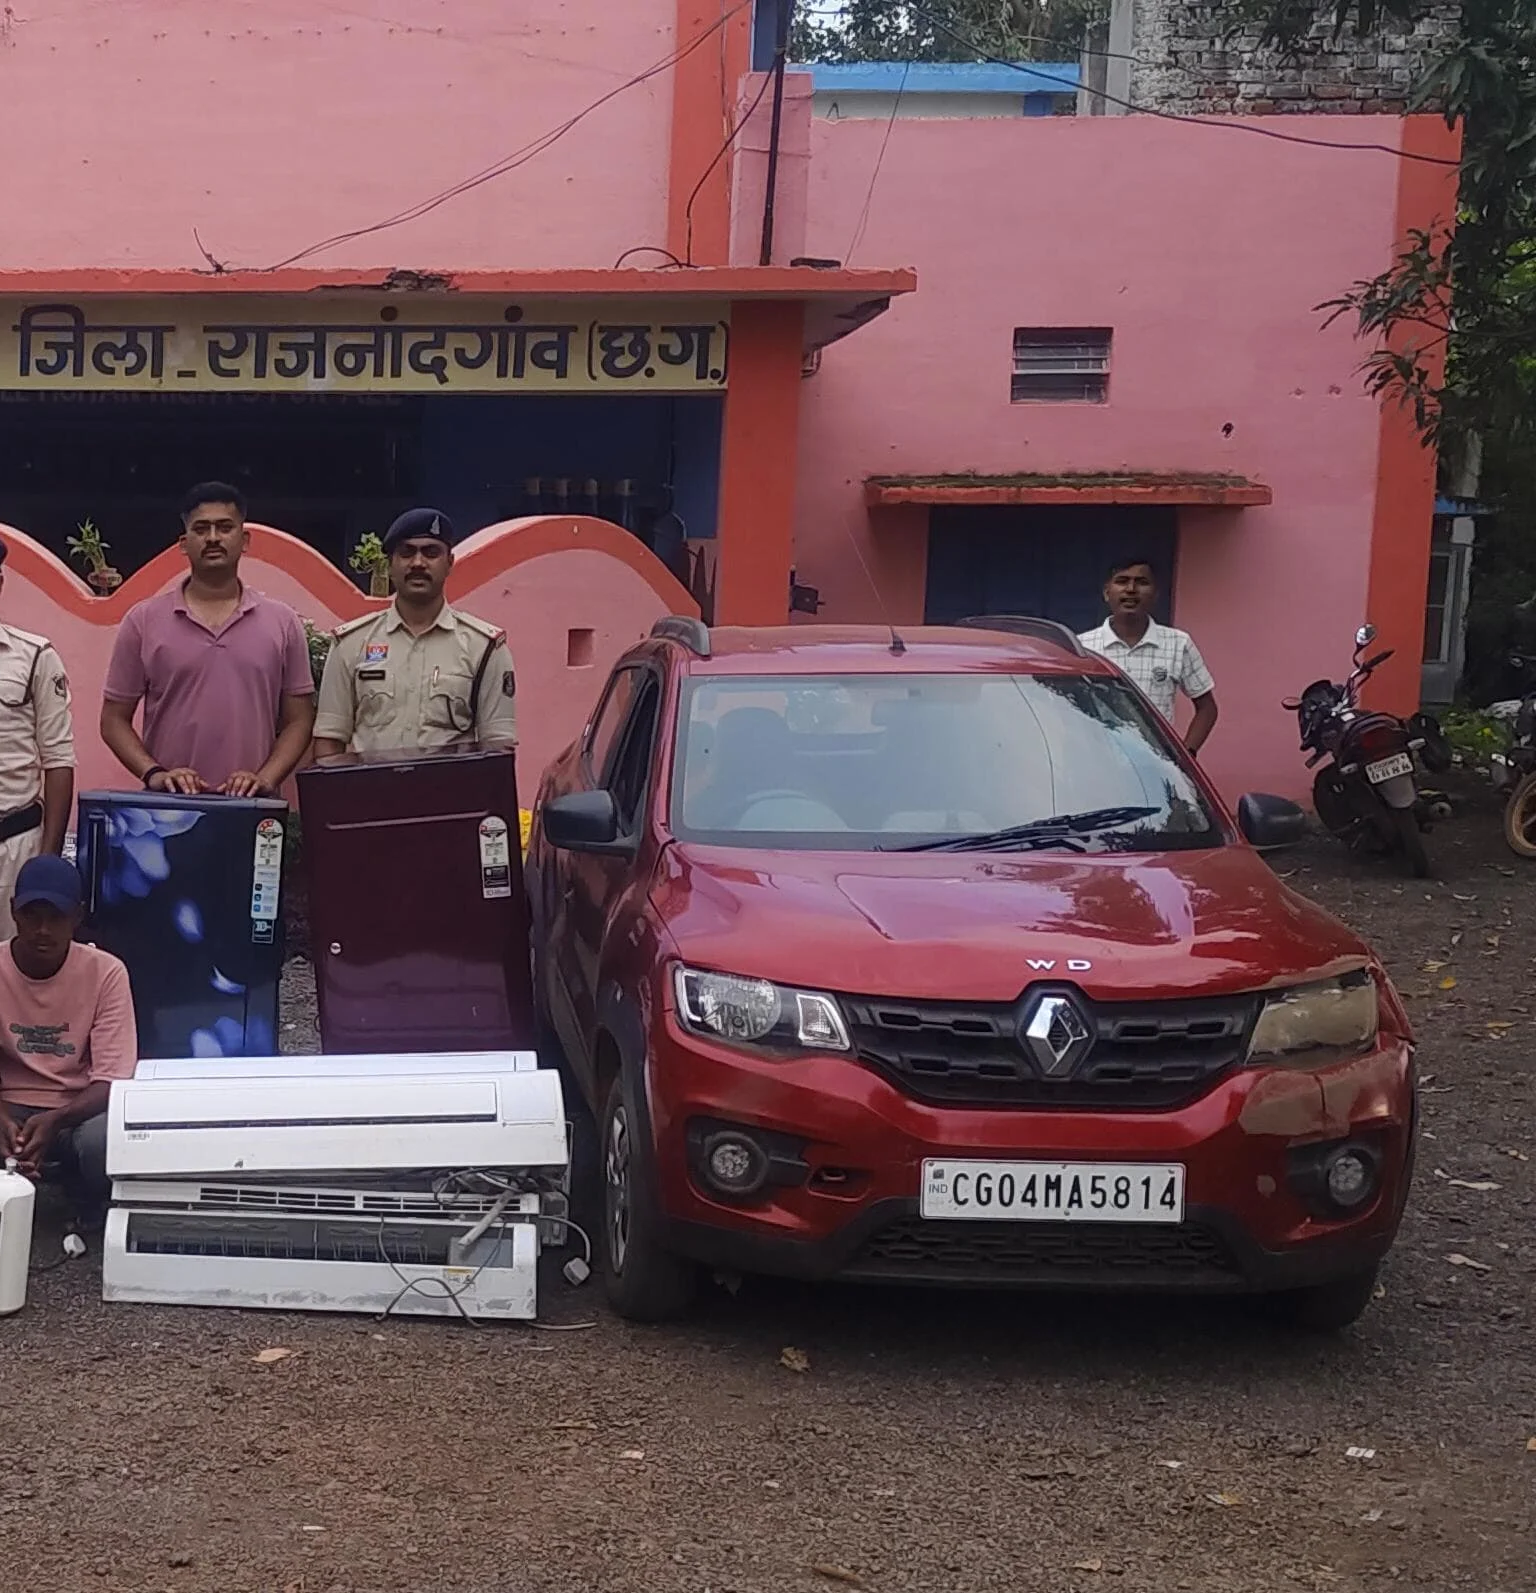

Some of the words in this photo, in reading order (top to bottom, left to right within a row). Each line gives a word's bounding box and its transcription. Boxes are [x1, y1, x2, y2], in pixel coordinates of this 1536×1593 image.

[203, 305, 578, 385] राजनांदगांव
[928, 1184, 949, 1195] IND
[951, 1172, 1177, 1211] CG04MA5814
